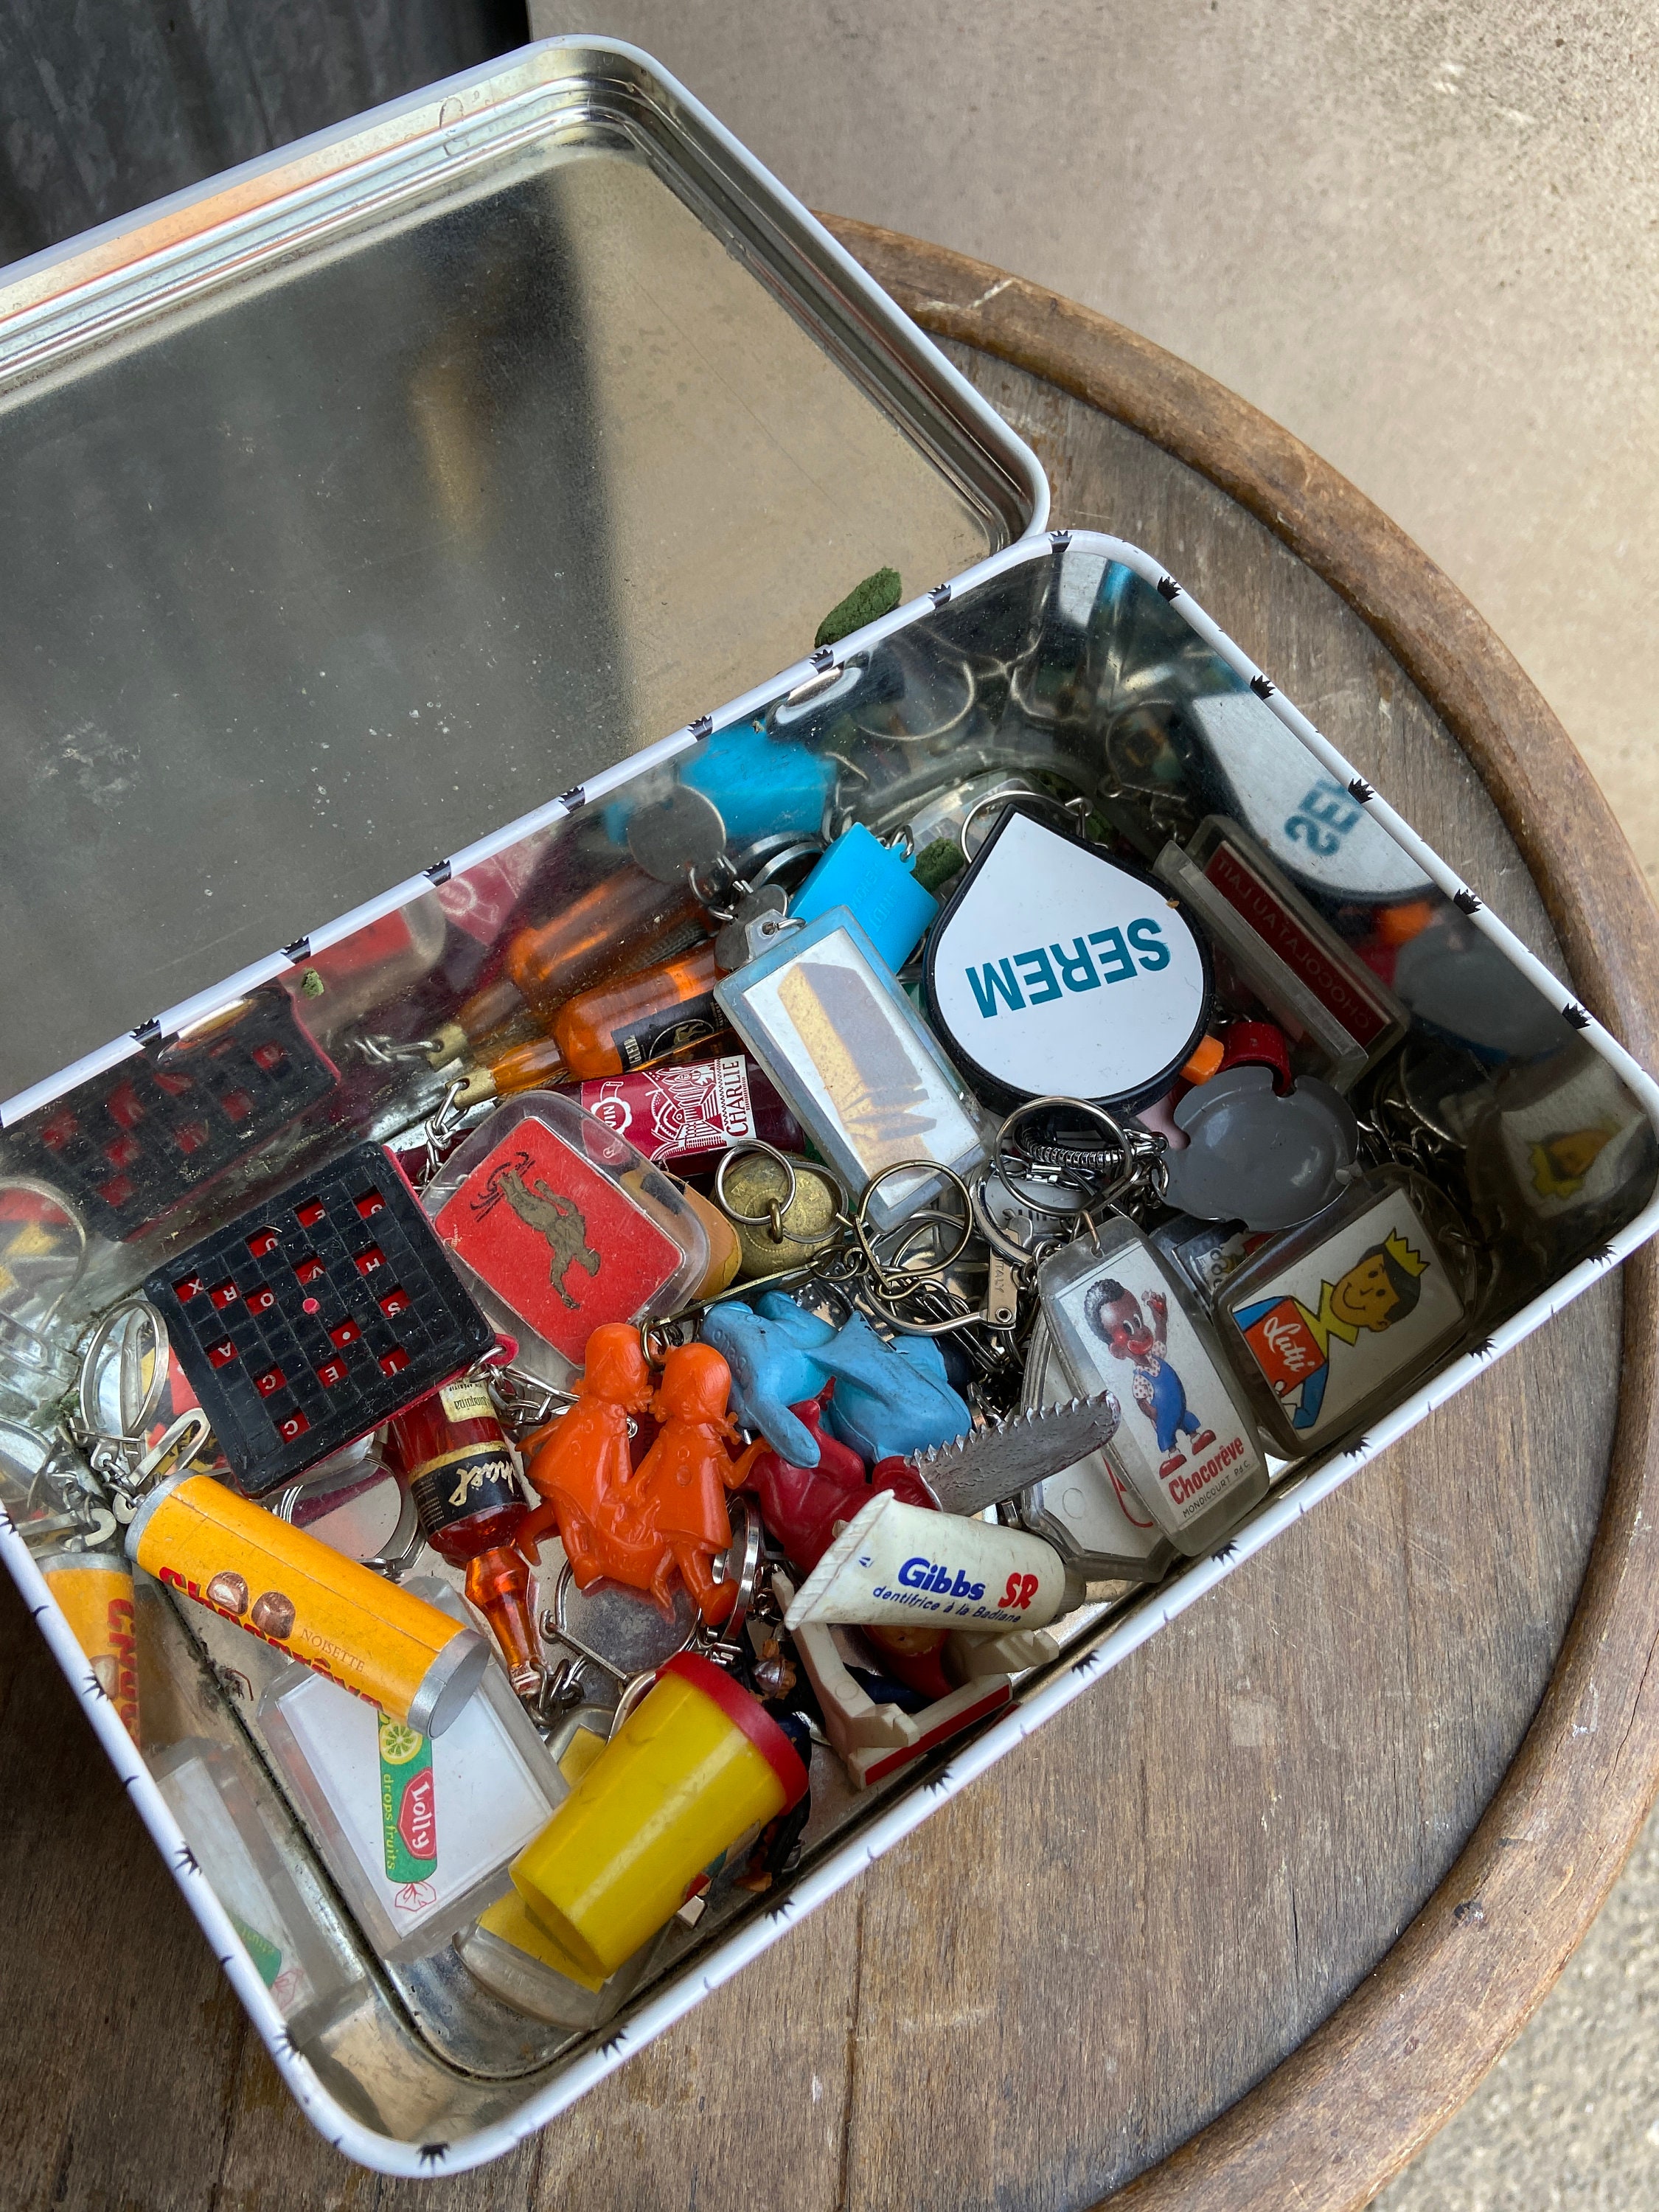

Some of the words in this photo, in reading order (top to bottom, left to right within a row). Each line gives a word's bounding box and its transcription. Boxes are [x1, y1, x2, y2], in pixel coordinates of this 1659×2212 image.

[965, 917, 1172, 1019] SEREM
[602, 1105, 616, 1127] VIN
[722, 1060, 749, 1137] CHARLIE
[995, 1258, 1005, 1293] ITALY
[1263, 1317, 1315, 1372] Lutti
[1169, 1437, 1245, 1505] Chocorêve
[1182, 1475, 1230, 1518] MONDICOURT
[897, 1557, 987, 1601] Gibbs
[998, 1572, 1039, 1610] SR
[872, 1585, 941, 1611] dentifrice
[942, 1600, 955, 1613] à
[957, 1603, 970, 1616] la
[972, 1605, 1022, 1624] Badiane
[300, 1627, 366, 1672] NOISETTE
[383, 1773, 394, 1820] drops
[411, 1781, 432, 1849] Lolly
[386, 1825, 398, 1870] fruits
